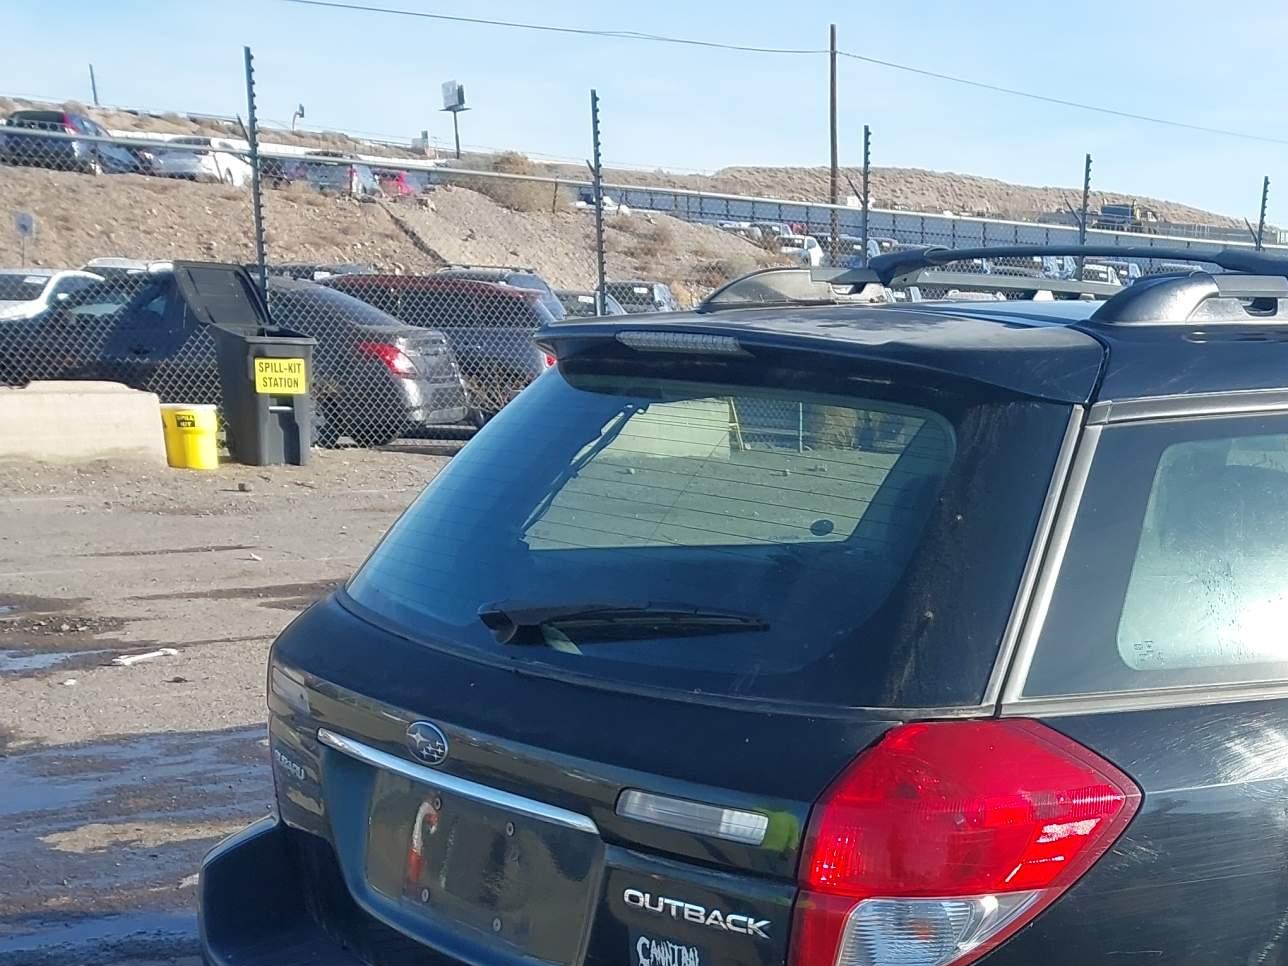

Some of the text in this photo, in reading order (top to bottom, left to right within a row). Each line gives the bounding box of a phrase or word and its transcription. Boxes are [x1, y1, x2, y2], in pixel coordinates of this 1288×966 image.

[258, 362, 301, 373] SPILL-KIT
[262, 377, 299, 389] STATION
[624, 889, 771, 939] OUTBACK
